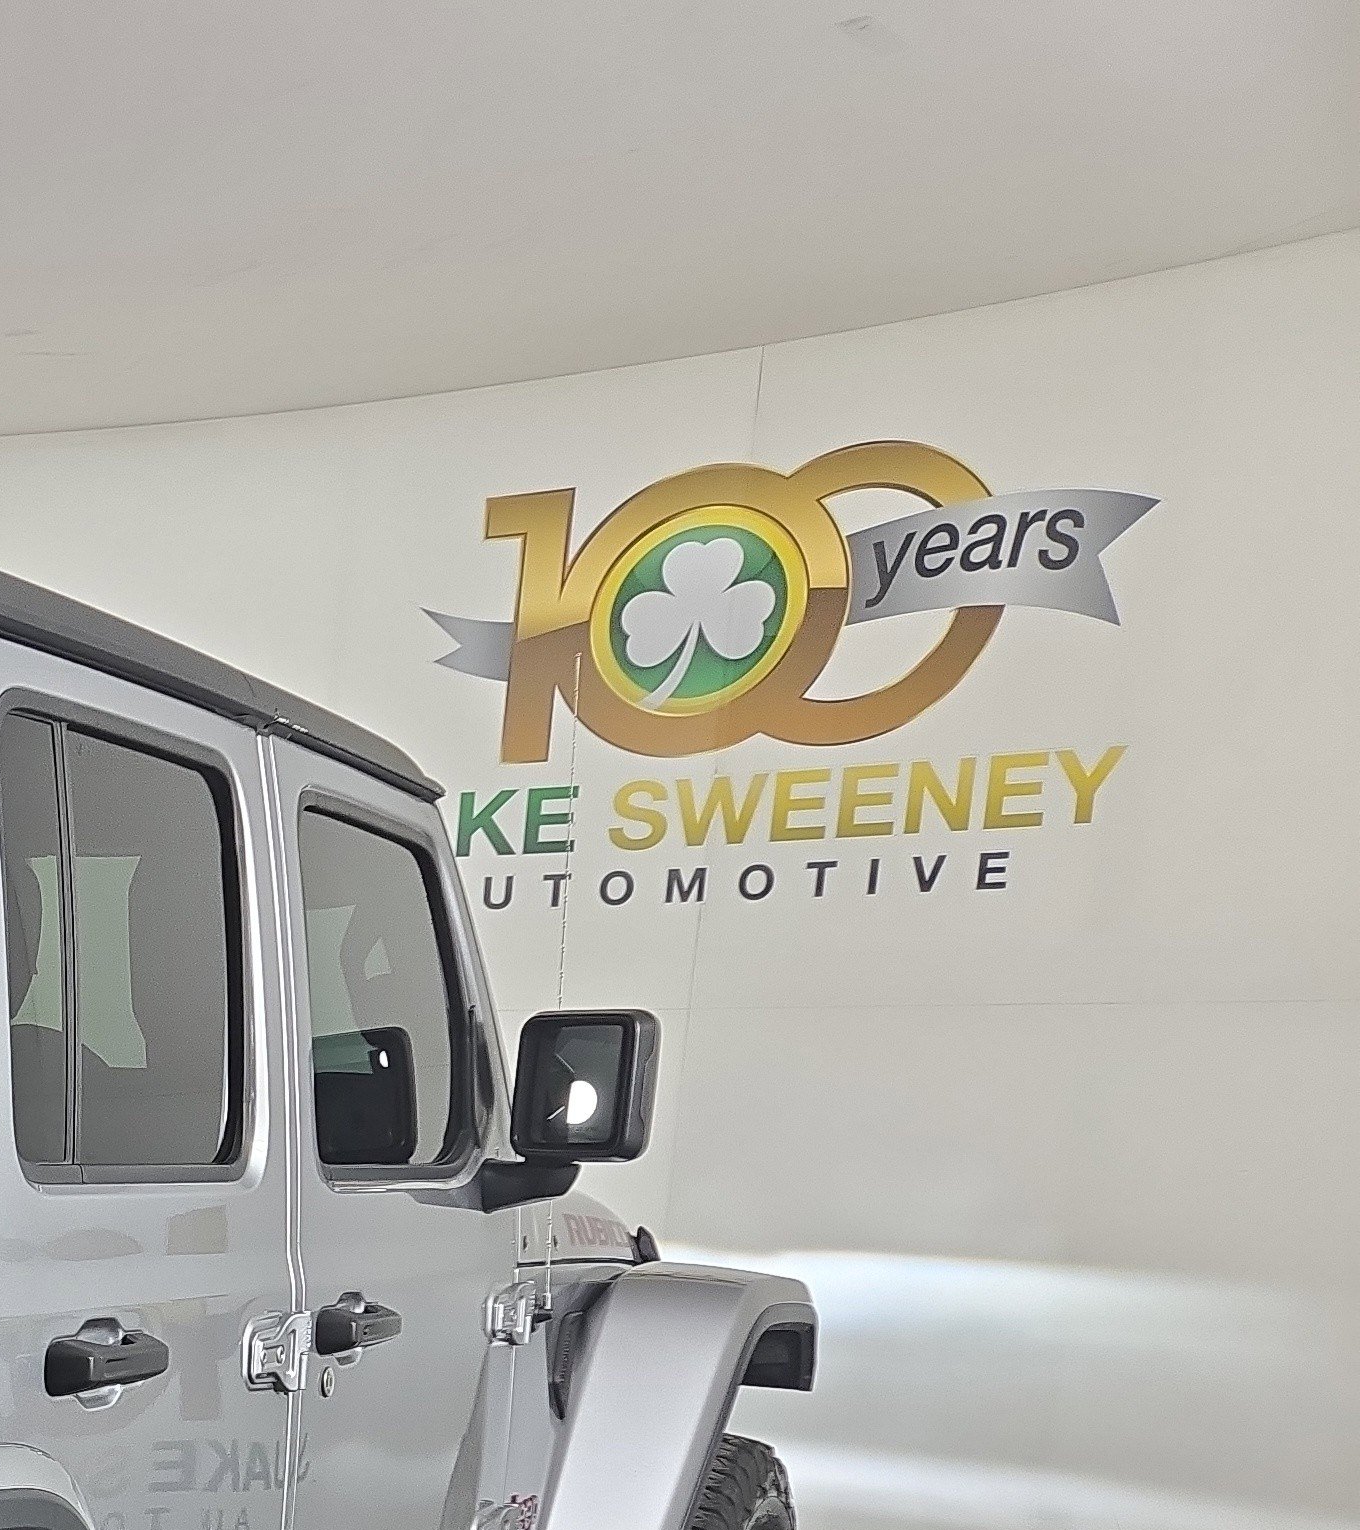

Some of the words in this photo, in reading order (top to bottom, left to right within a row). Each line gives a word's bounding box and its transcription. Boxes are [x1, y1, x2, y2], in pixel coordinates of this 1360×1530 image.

[485, 440, 1007, 764] 100
[865, 507, 1085, 609] years
[455, 785, 580, 858] KE
[607, 745, 1128, 851] SWEENEY
[483, 851, 1012, 911] UTOMOTIVE
[561, 1213, 631, 1248] RUBIC
